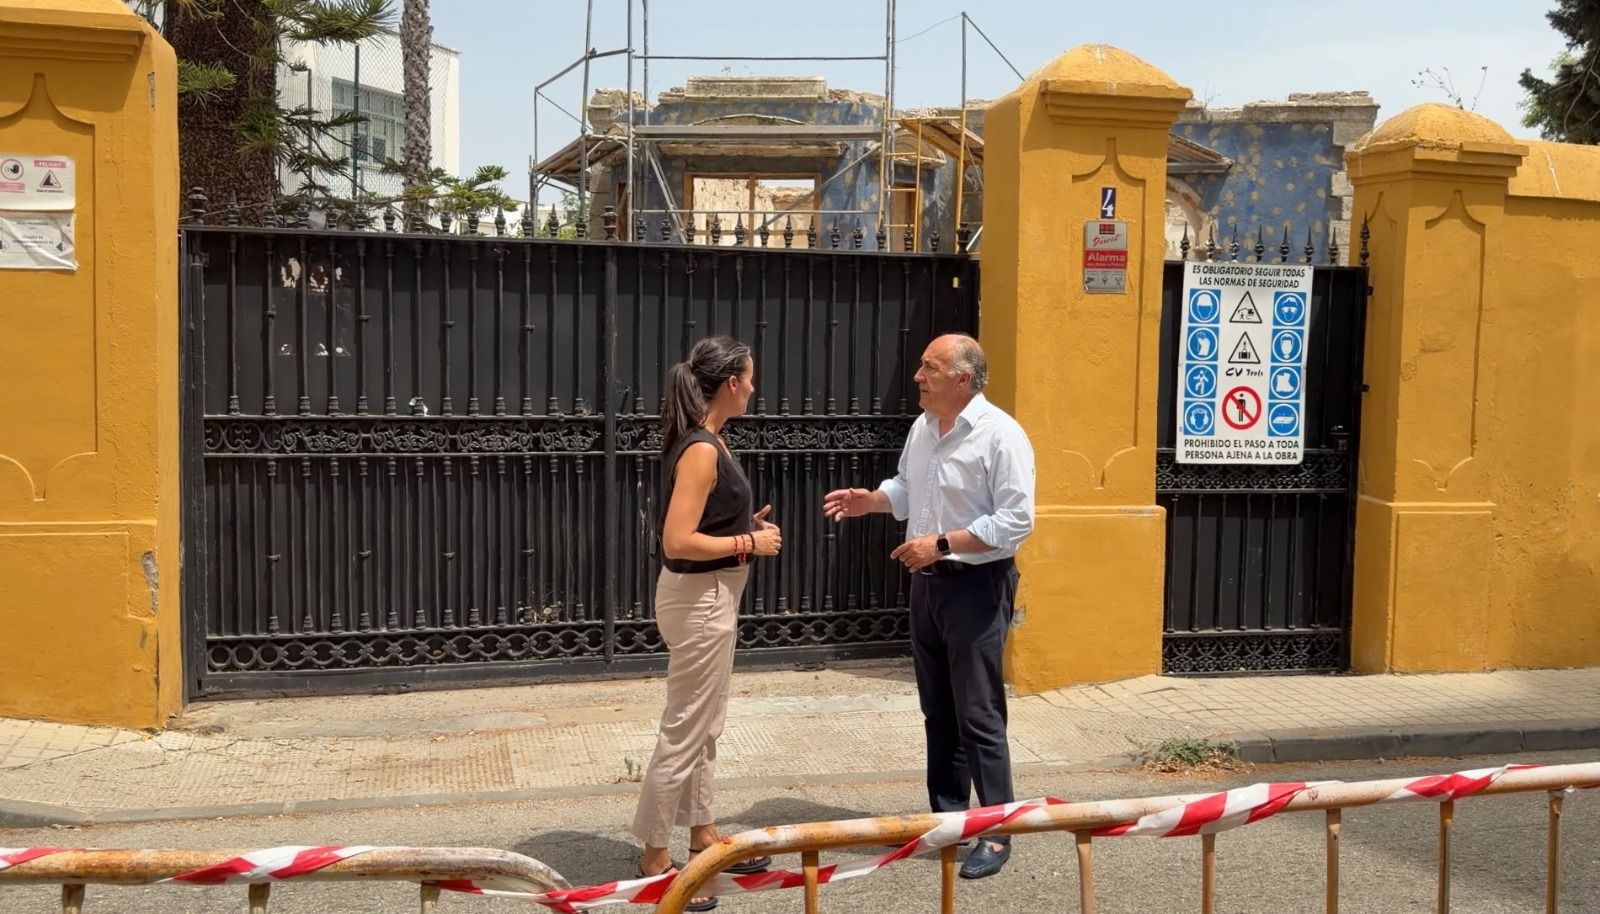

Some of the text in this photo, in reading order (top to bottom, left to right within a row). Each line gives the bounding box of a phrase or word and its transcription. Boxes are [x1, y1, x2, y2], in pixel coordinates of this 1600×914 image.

[1101, 189, 1115, 217] 4
[1088, 252, 1126, 262] Alarma
[1192, 265, 1306, 278] ES OBLIGATORIO SEGUIR TODAS
[1199, 277, 1300, 288] LAS NORMAS DE SEGURIDAD
[1225, 367, 1243, 377] CV
[1184, 439, 1299, 449] PROHIBIDO EL PASO A TODA
[1185, 450, 1298, 461] PERSONA AJENA A LA OBRA
